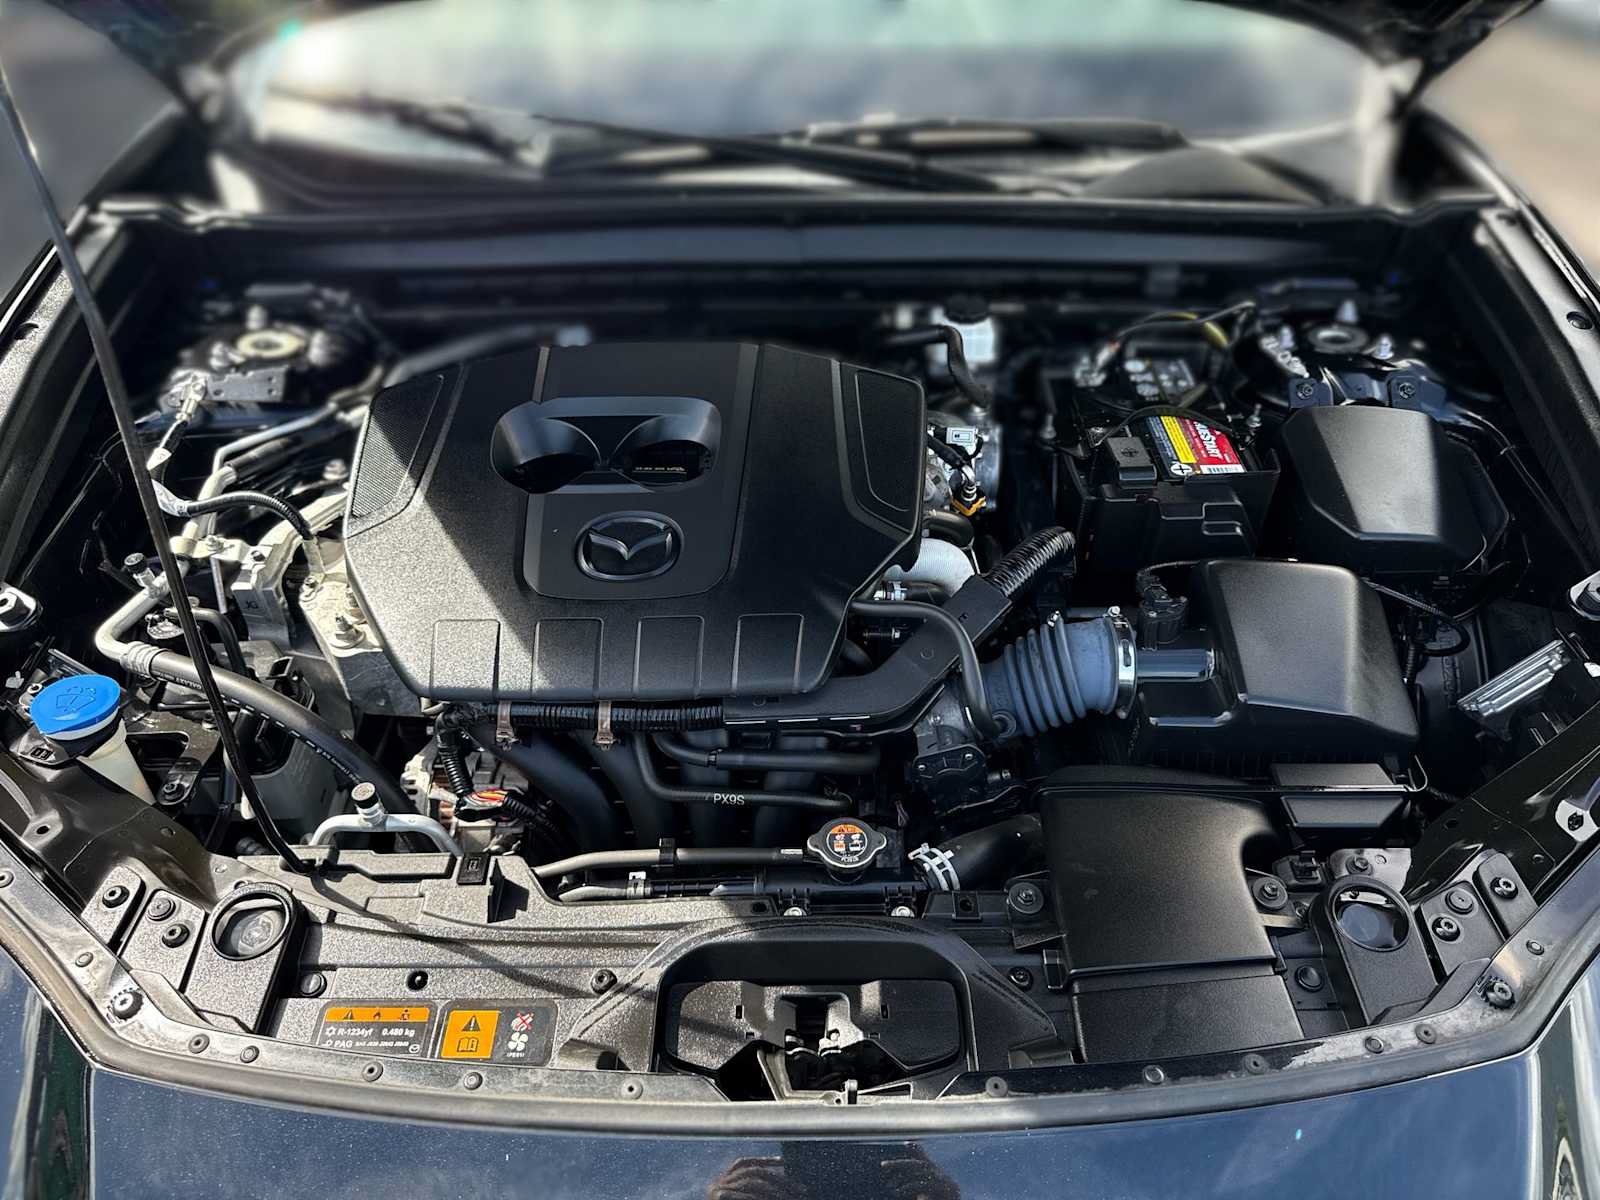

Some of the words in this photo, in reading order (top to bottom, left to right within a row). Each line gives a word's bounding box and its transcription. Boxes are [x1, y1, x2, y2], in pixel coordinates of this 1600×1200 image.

[713, 792, 745, 806] PX9S
[337, 1027, 374, 1038] R-1234yf
[404, 1028, 416, 1038] kg
[334, 1040, 353, 1048] PAG
